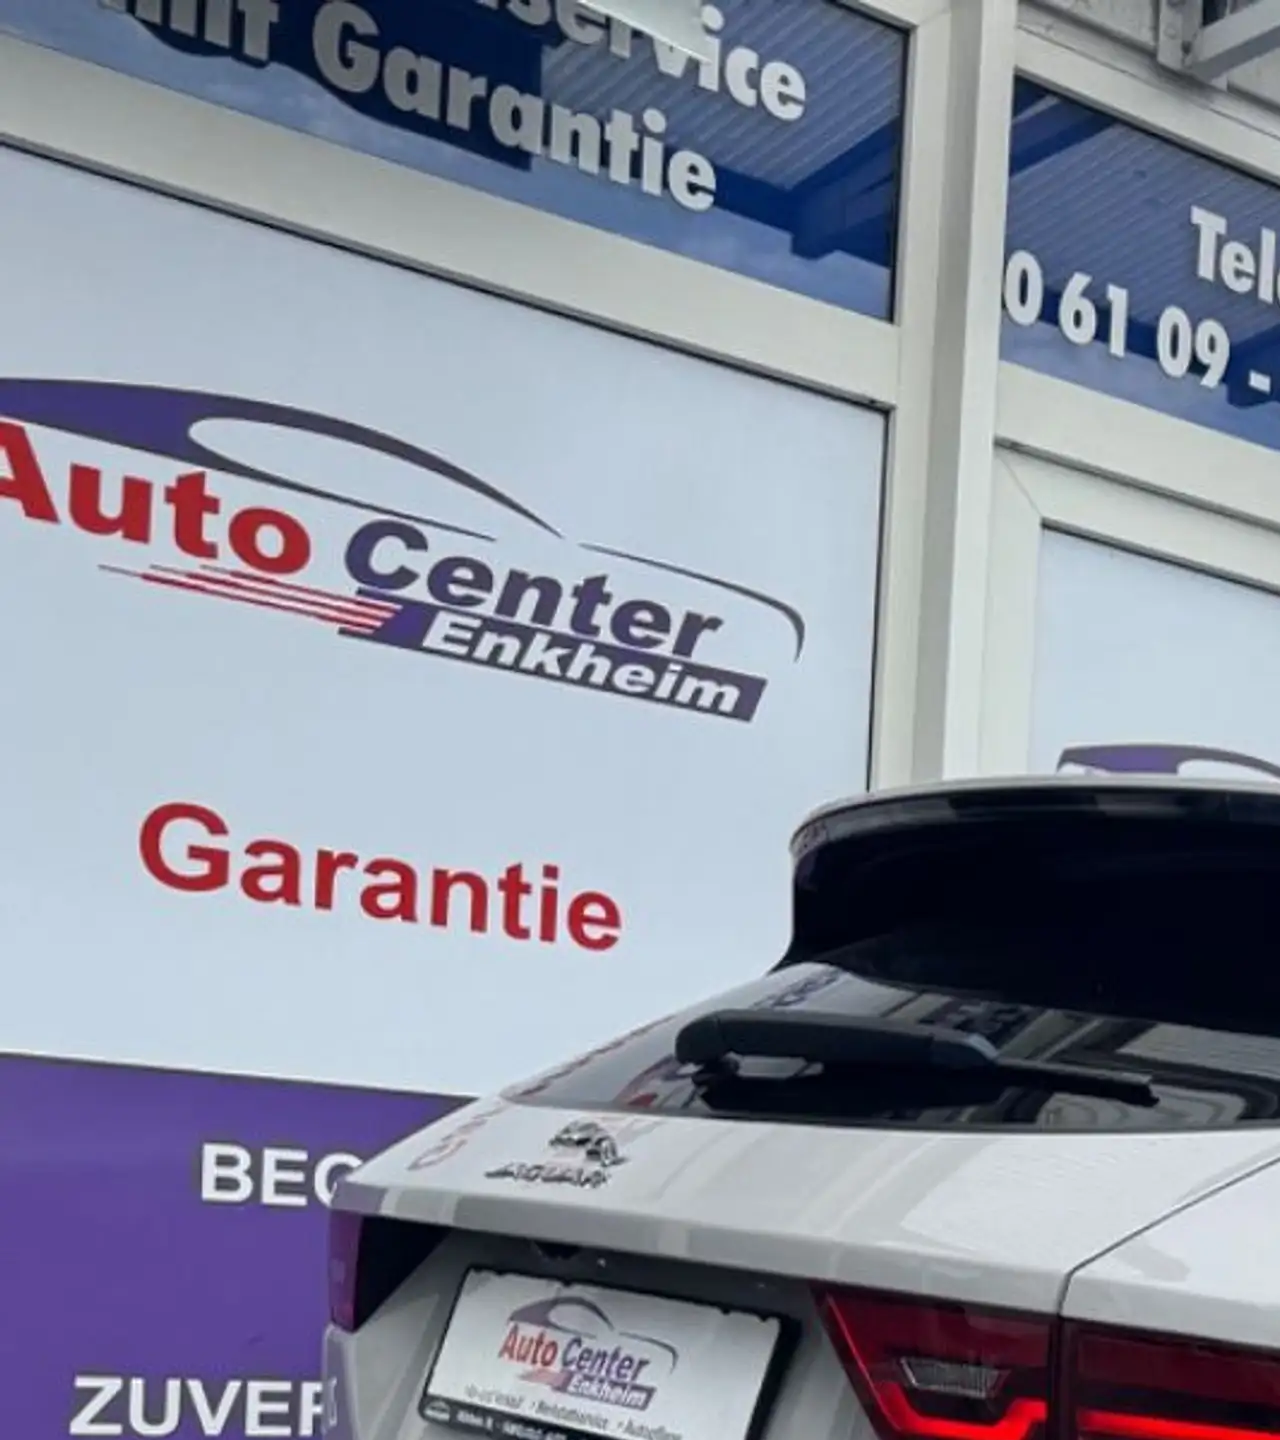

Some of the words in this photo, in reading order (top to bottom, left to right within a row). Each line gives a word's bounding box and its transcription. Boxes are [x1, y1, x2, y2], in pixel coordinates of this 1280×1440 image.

[312, 1, 717, 211] Garantie
[1004, 250, 1044, 326] 0
[1058, 272, 1128, 357] 61
[1156, 306, 1231, 388] 09
[0, 421, 312, 574] Auto
[344, 519, 724, 658] Center
[421, 614, 743, 714] Enkheim
[139, 802, 623, 951] Garantie
[498, 1323, 559, 1367] Auto
[562, 1336, 651, 1382] Center
